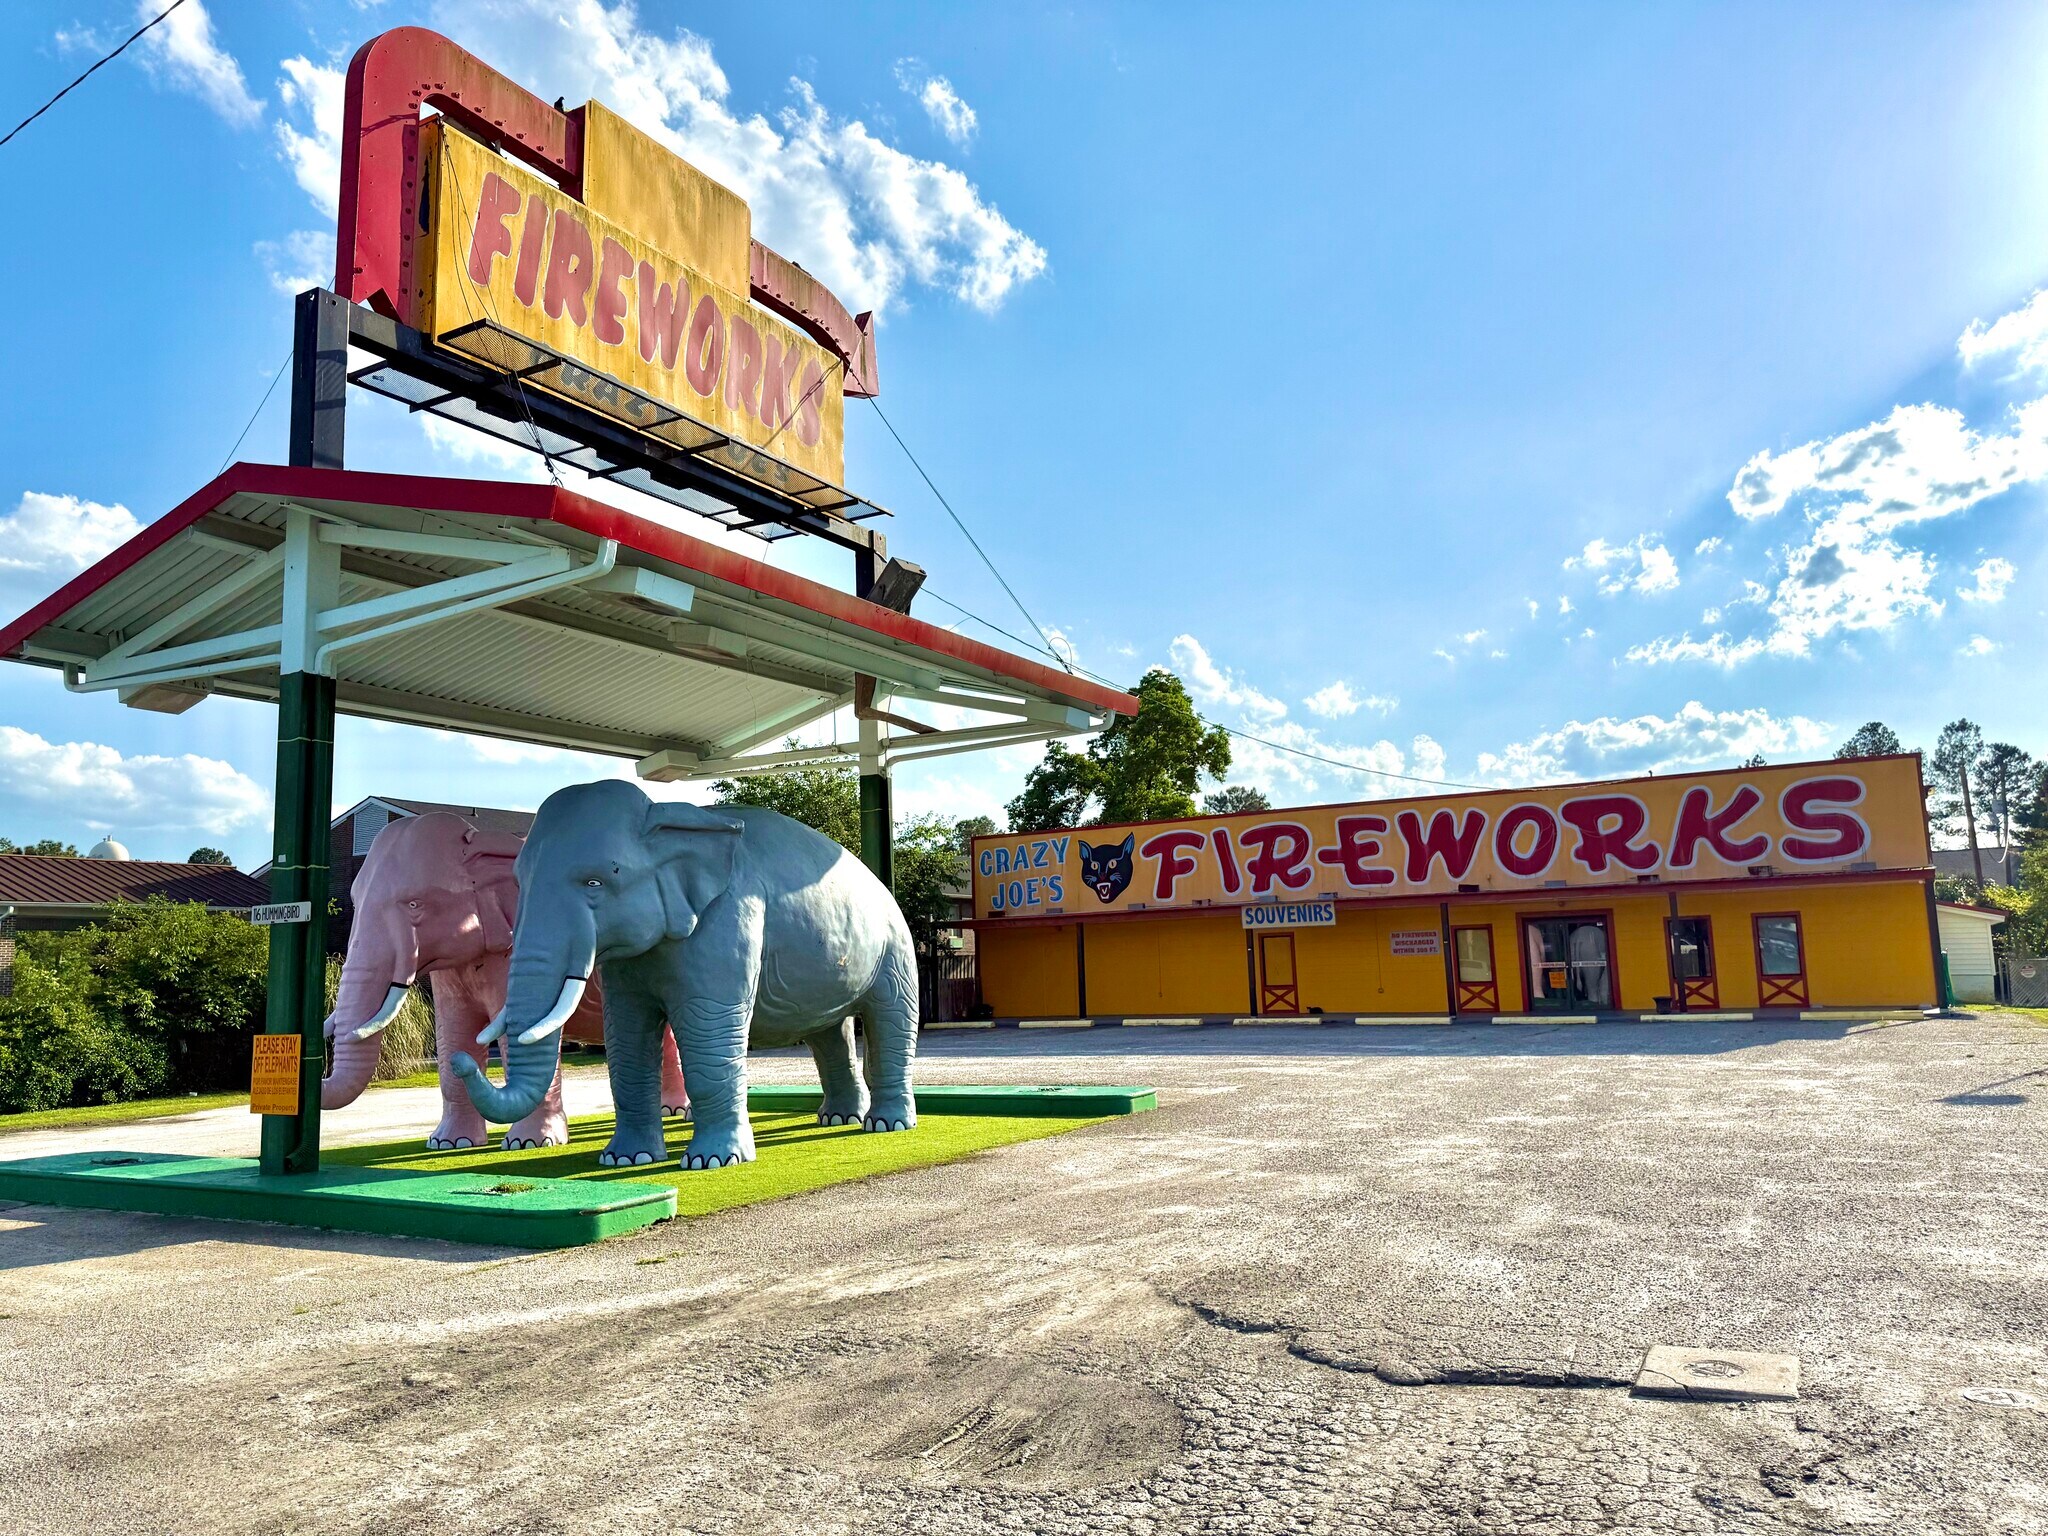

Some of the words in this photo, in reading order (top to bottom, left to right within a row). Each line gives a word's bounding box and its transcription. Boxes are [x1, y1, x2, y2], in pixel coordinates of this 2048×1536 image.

[468, 171, 827, 447] FIREWORKS
[1140, 775, 1871, 901] FIREWORKS
[979, 836, 1071, 877] CRAZY
[991, 874, 1064, 911] JOE'S
[262, 905, 300, 920] HUMMINGBIRD
[1245, 903, 1334, 925] SOUVENIRS
[255, 1037, 280, 1055] PLEASE
[280, 1036, 298, 1054] STAY
[253, 1056, 264, 1073] OFF
[264, 1055, 298, 1073] ELEPHANTS
[252, 1103, 271, 1111] Private
[272, 1103, 297, 1113] Property
